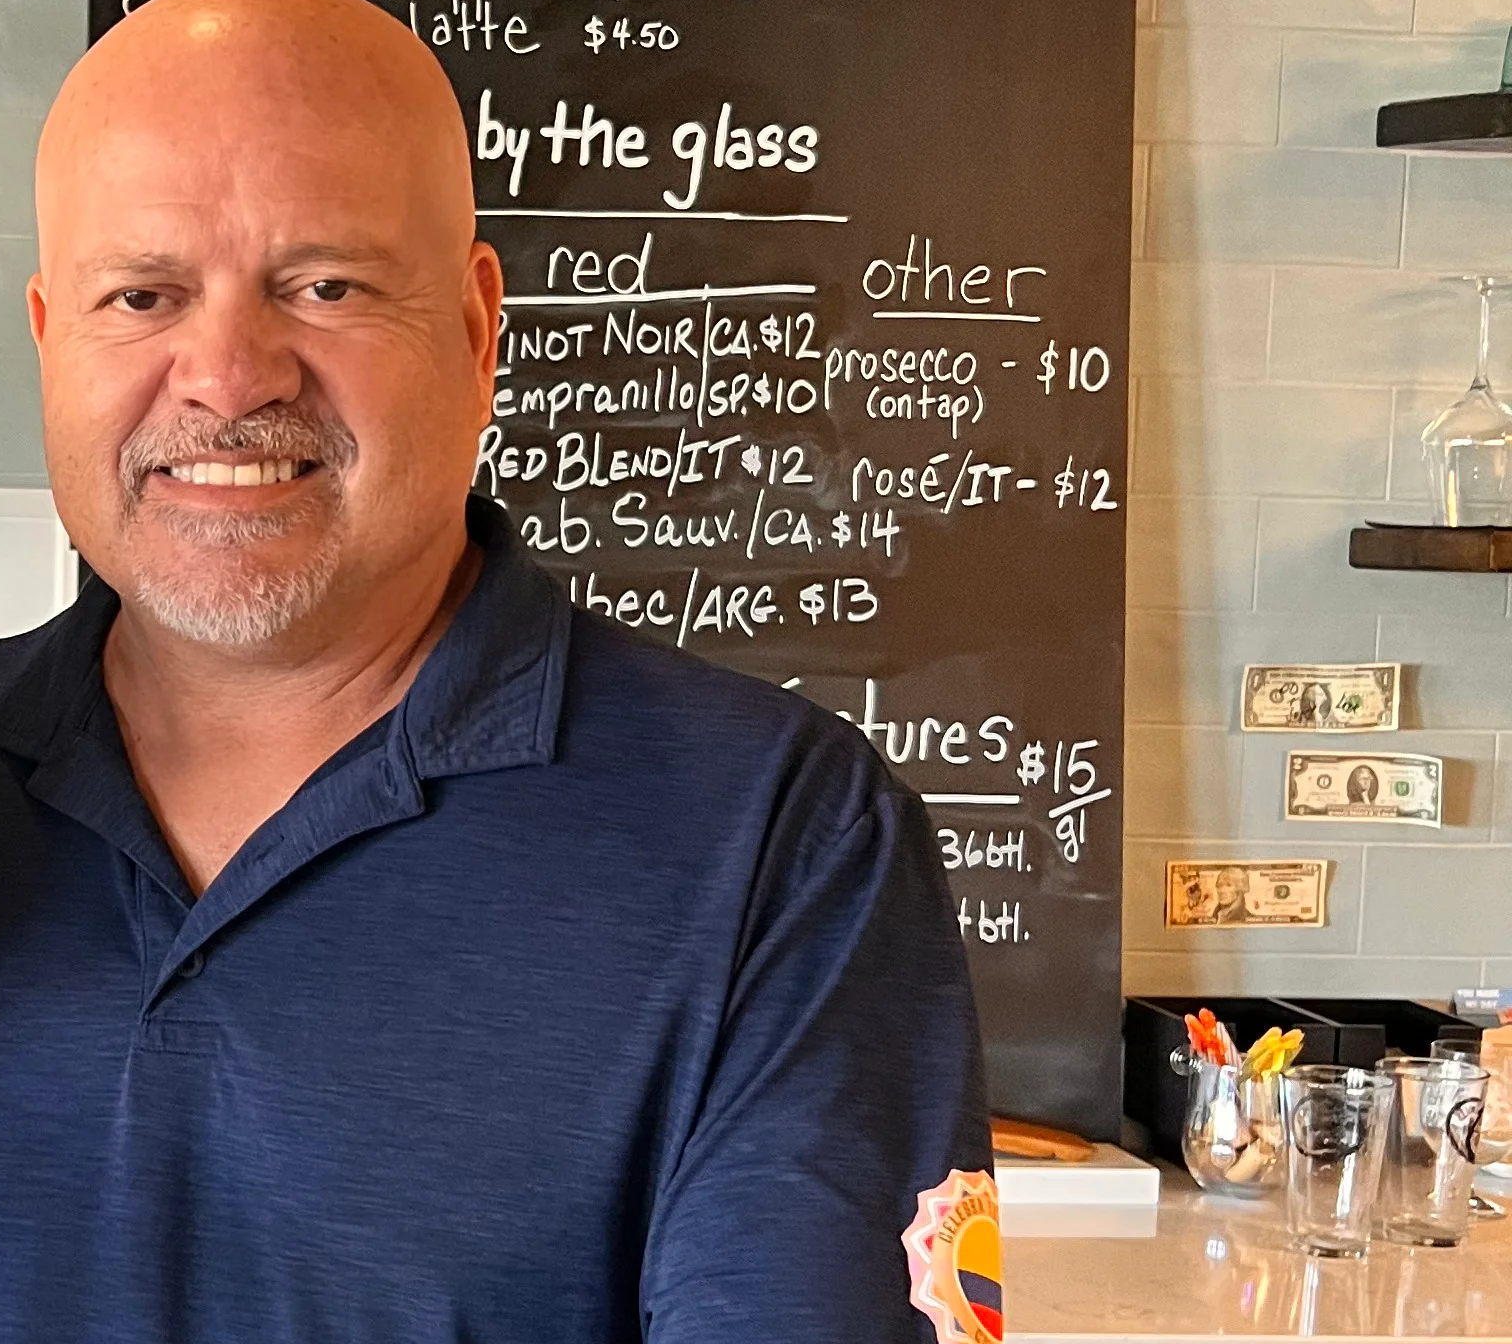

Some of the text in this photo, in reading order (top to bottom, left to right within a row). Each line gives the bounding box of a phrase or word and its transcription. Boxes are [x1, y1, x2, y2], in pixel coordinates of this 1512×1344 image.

[409, 1, 680, 55] latte $4.50
[477, 89, 819, 210] by the glass
[547, 231, 653, 296] red
[862, 234, 1047, 310] other
[823, 347, 977, 411] prosecco
[1037, 339, 1110, 395] $10
[471, 425, 548, 496] RED
[1054, 455, 1118, 511] $12
[831, 509, 900, 557] $14
[799, 578, 879, 625] $13
